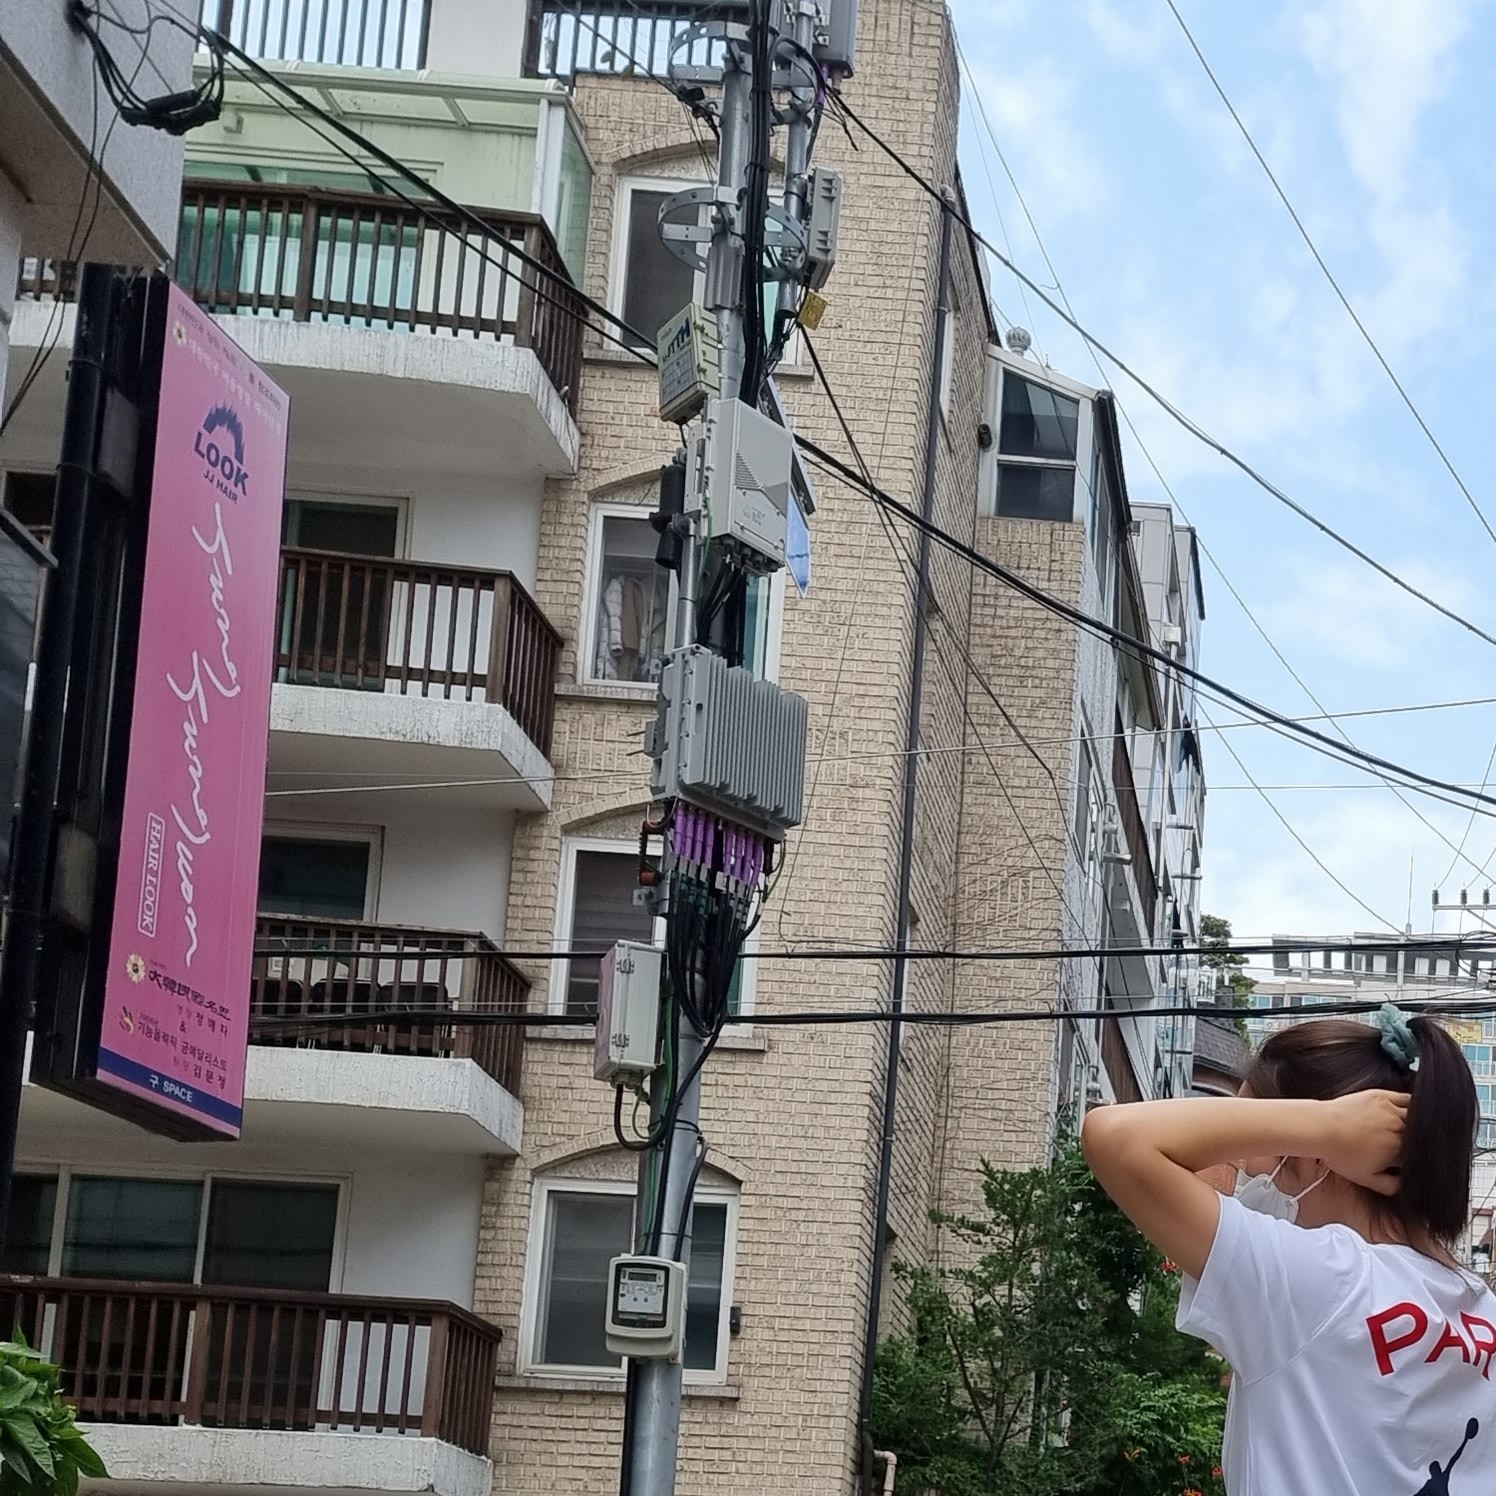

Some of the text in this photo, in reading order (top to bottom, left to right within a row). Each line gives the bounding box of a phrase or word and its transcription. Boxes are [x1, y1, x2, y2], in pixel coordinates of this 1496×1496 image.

[194, 431, 249, 497] LOOK
[203, 470, 238, 504] JJ HAIR
[142, 819, 163, 933] HAIR LOOK
[179, 1021, 188, 1034] &
[149, 1074, 194, 1103] 구 SPACE
